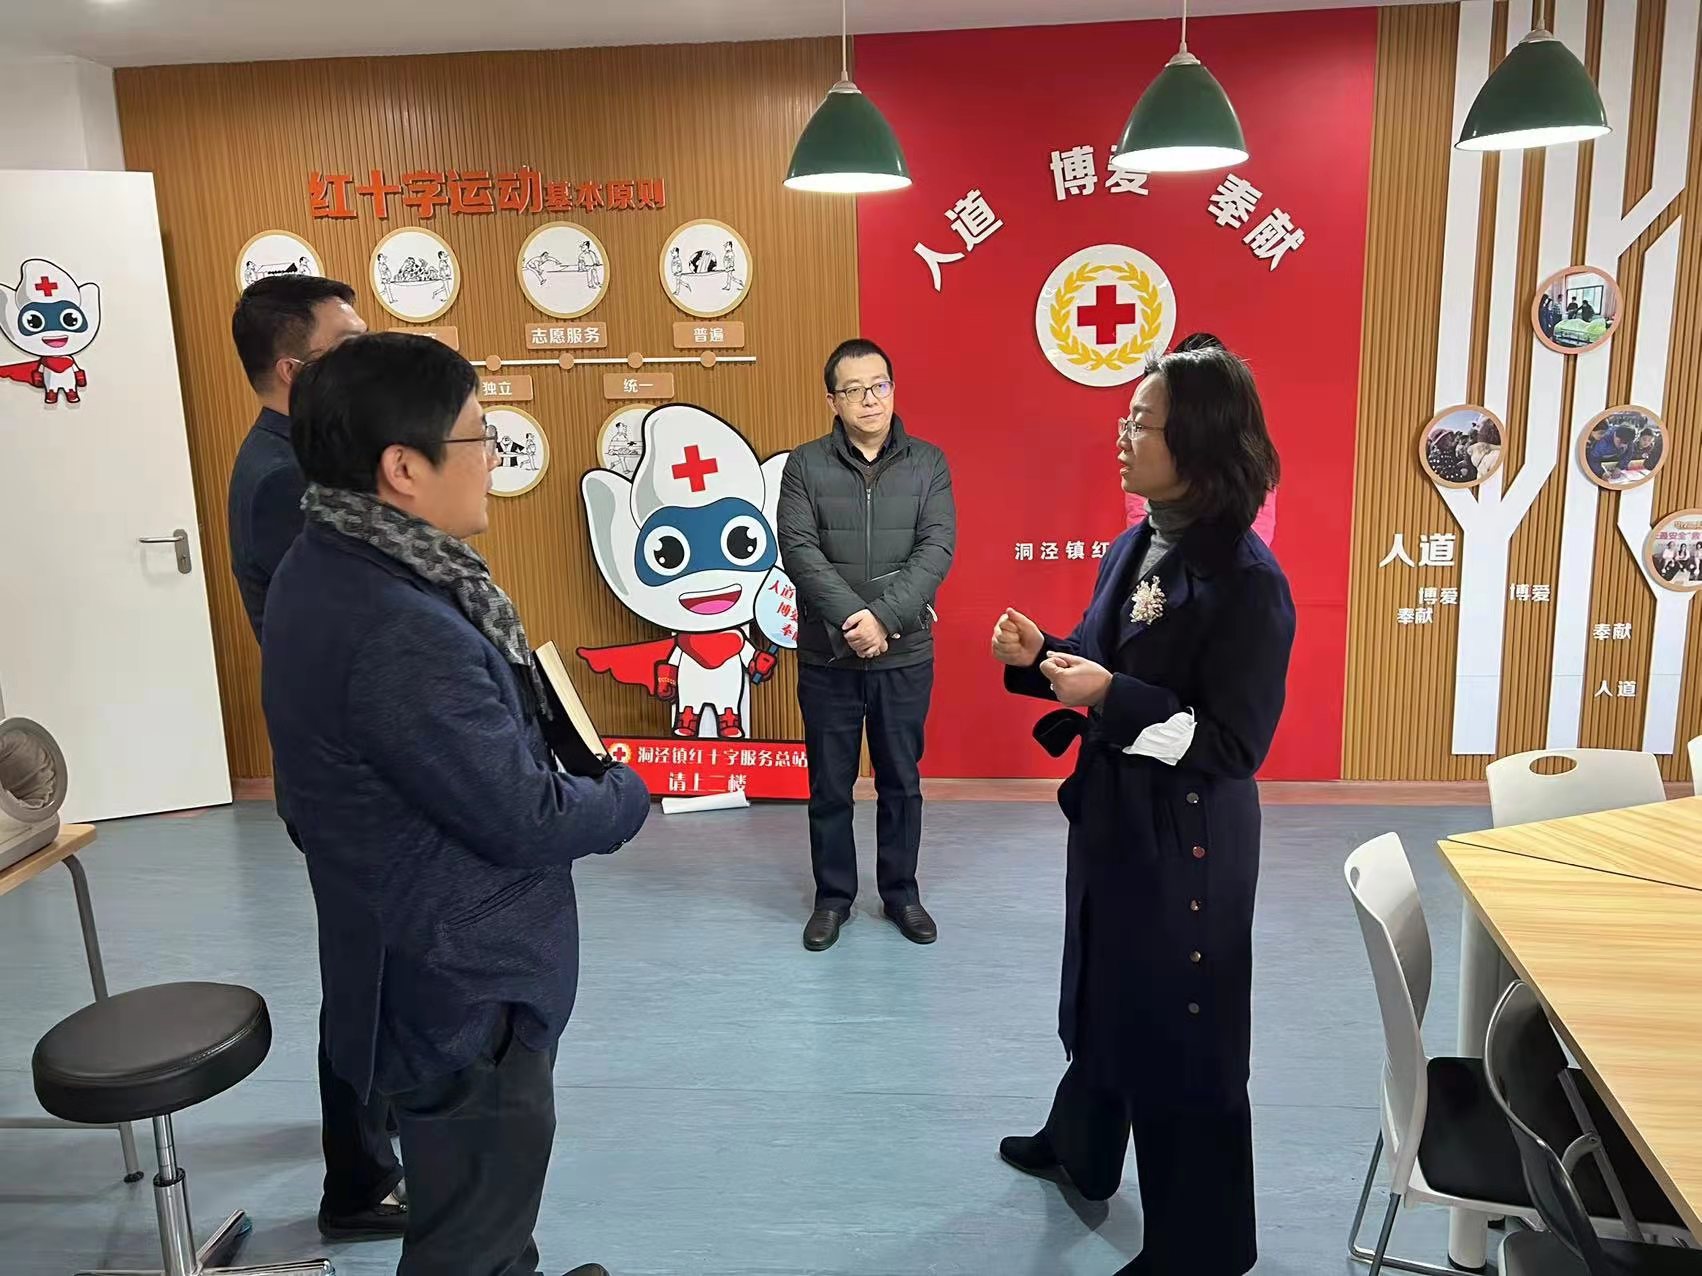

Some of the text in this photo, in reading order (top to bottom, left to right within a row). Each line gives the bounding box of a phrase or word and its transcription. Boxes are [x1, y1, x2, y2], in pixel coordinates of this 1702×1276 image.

[308, 165, 666, 219] 红十字运动基本原则
[913, 189, 1004, 292] 人道
[1208, 173, 1306, 272] 奉献
[531, 326, 601, 344] 志愿服务
[693, 328, 724, 343] 普遍
[482, 381, 512, 396] 独立
[623, 378, 653, 393] 统一
[1015, 540, 1110, 560] 洞泾镇红
[1378, 533, 1456, 568] 人道
[1418, 587, 1458, 605] 博爱
[1509, 583, 1551, 602] 博爱
[1397, 607, 1434, 625] 奉献
[782, 624, 799, 640] 奉
[1593, 622, 1632, 640] 奉献
[1594, 680, 1636, 697] 人道
[637, 746, 808, 768] 洞泾镇红十字服务总站
[668, 772, 747, 792] 请上二楼
